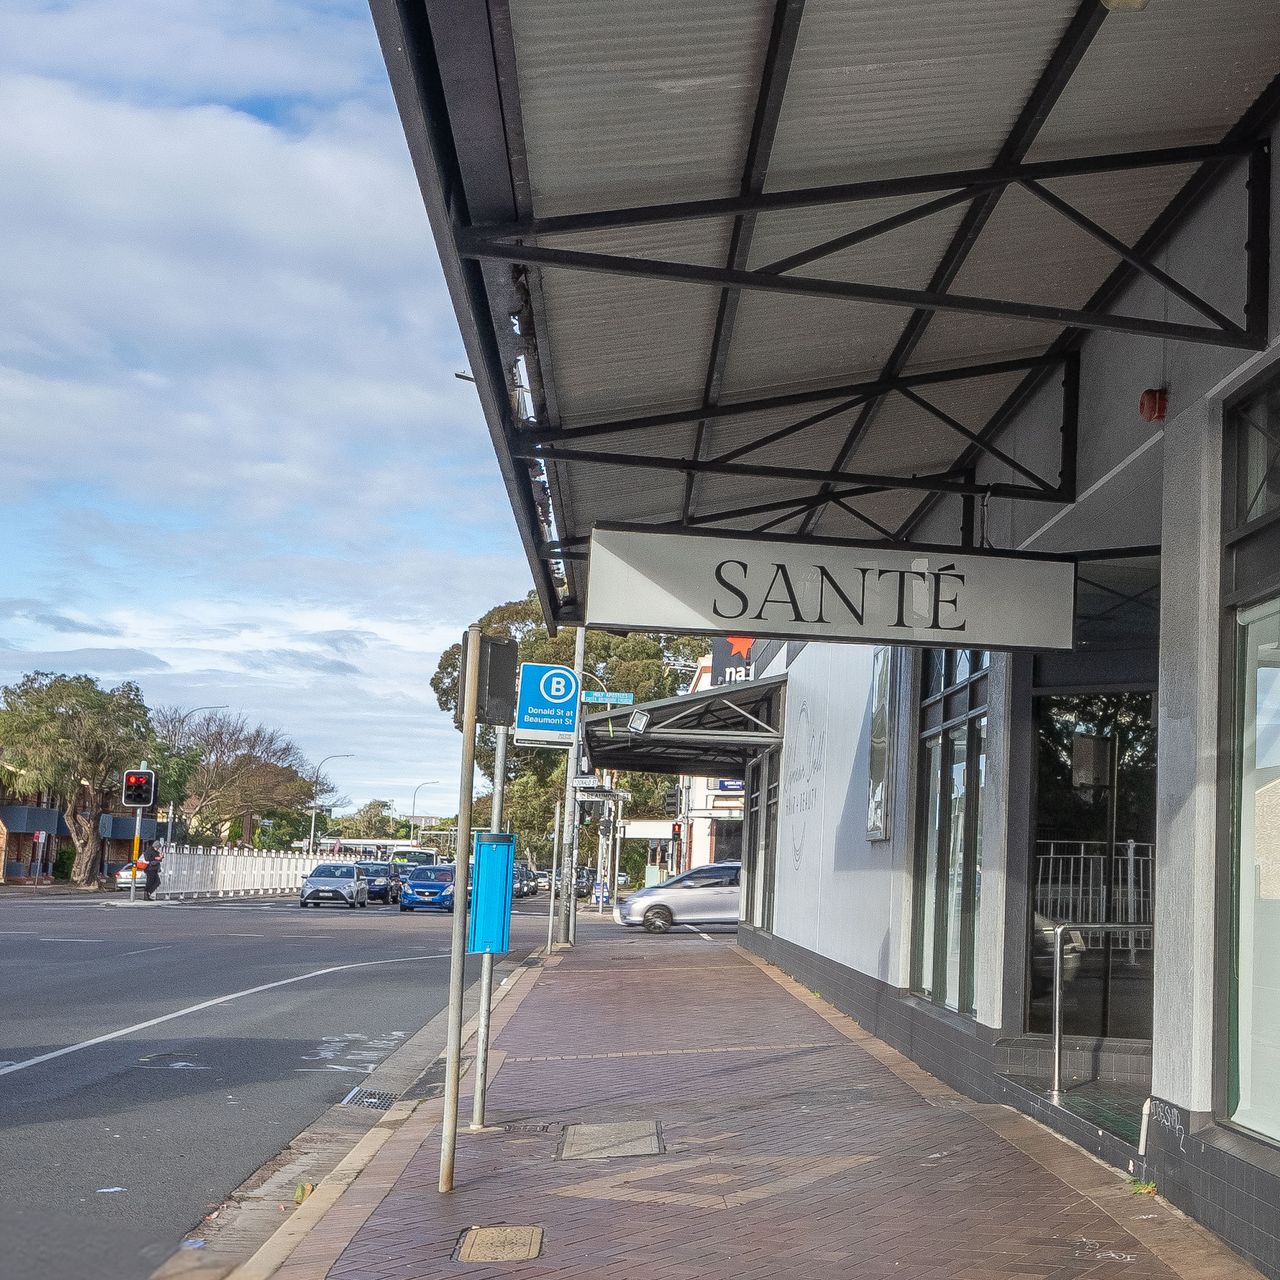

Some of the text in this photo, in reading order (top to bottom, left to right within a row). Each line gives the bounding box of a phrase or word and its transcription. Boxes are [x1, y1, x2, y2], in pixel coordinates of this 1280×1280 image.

[712, 559, 967, 632] SANTÉ
[725, 666, 751, 682] na
[550, 677, 566, 697] B
[528, 706, 555, 715] Donald
[556, 708, 564, 716] St
[524, 714, 573, 725] Beaumont St
[587, 792, 619, 800] BEAUMONT
